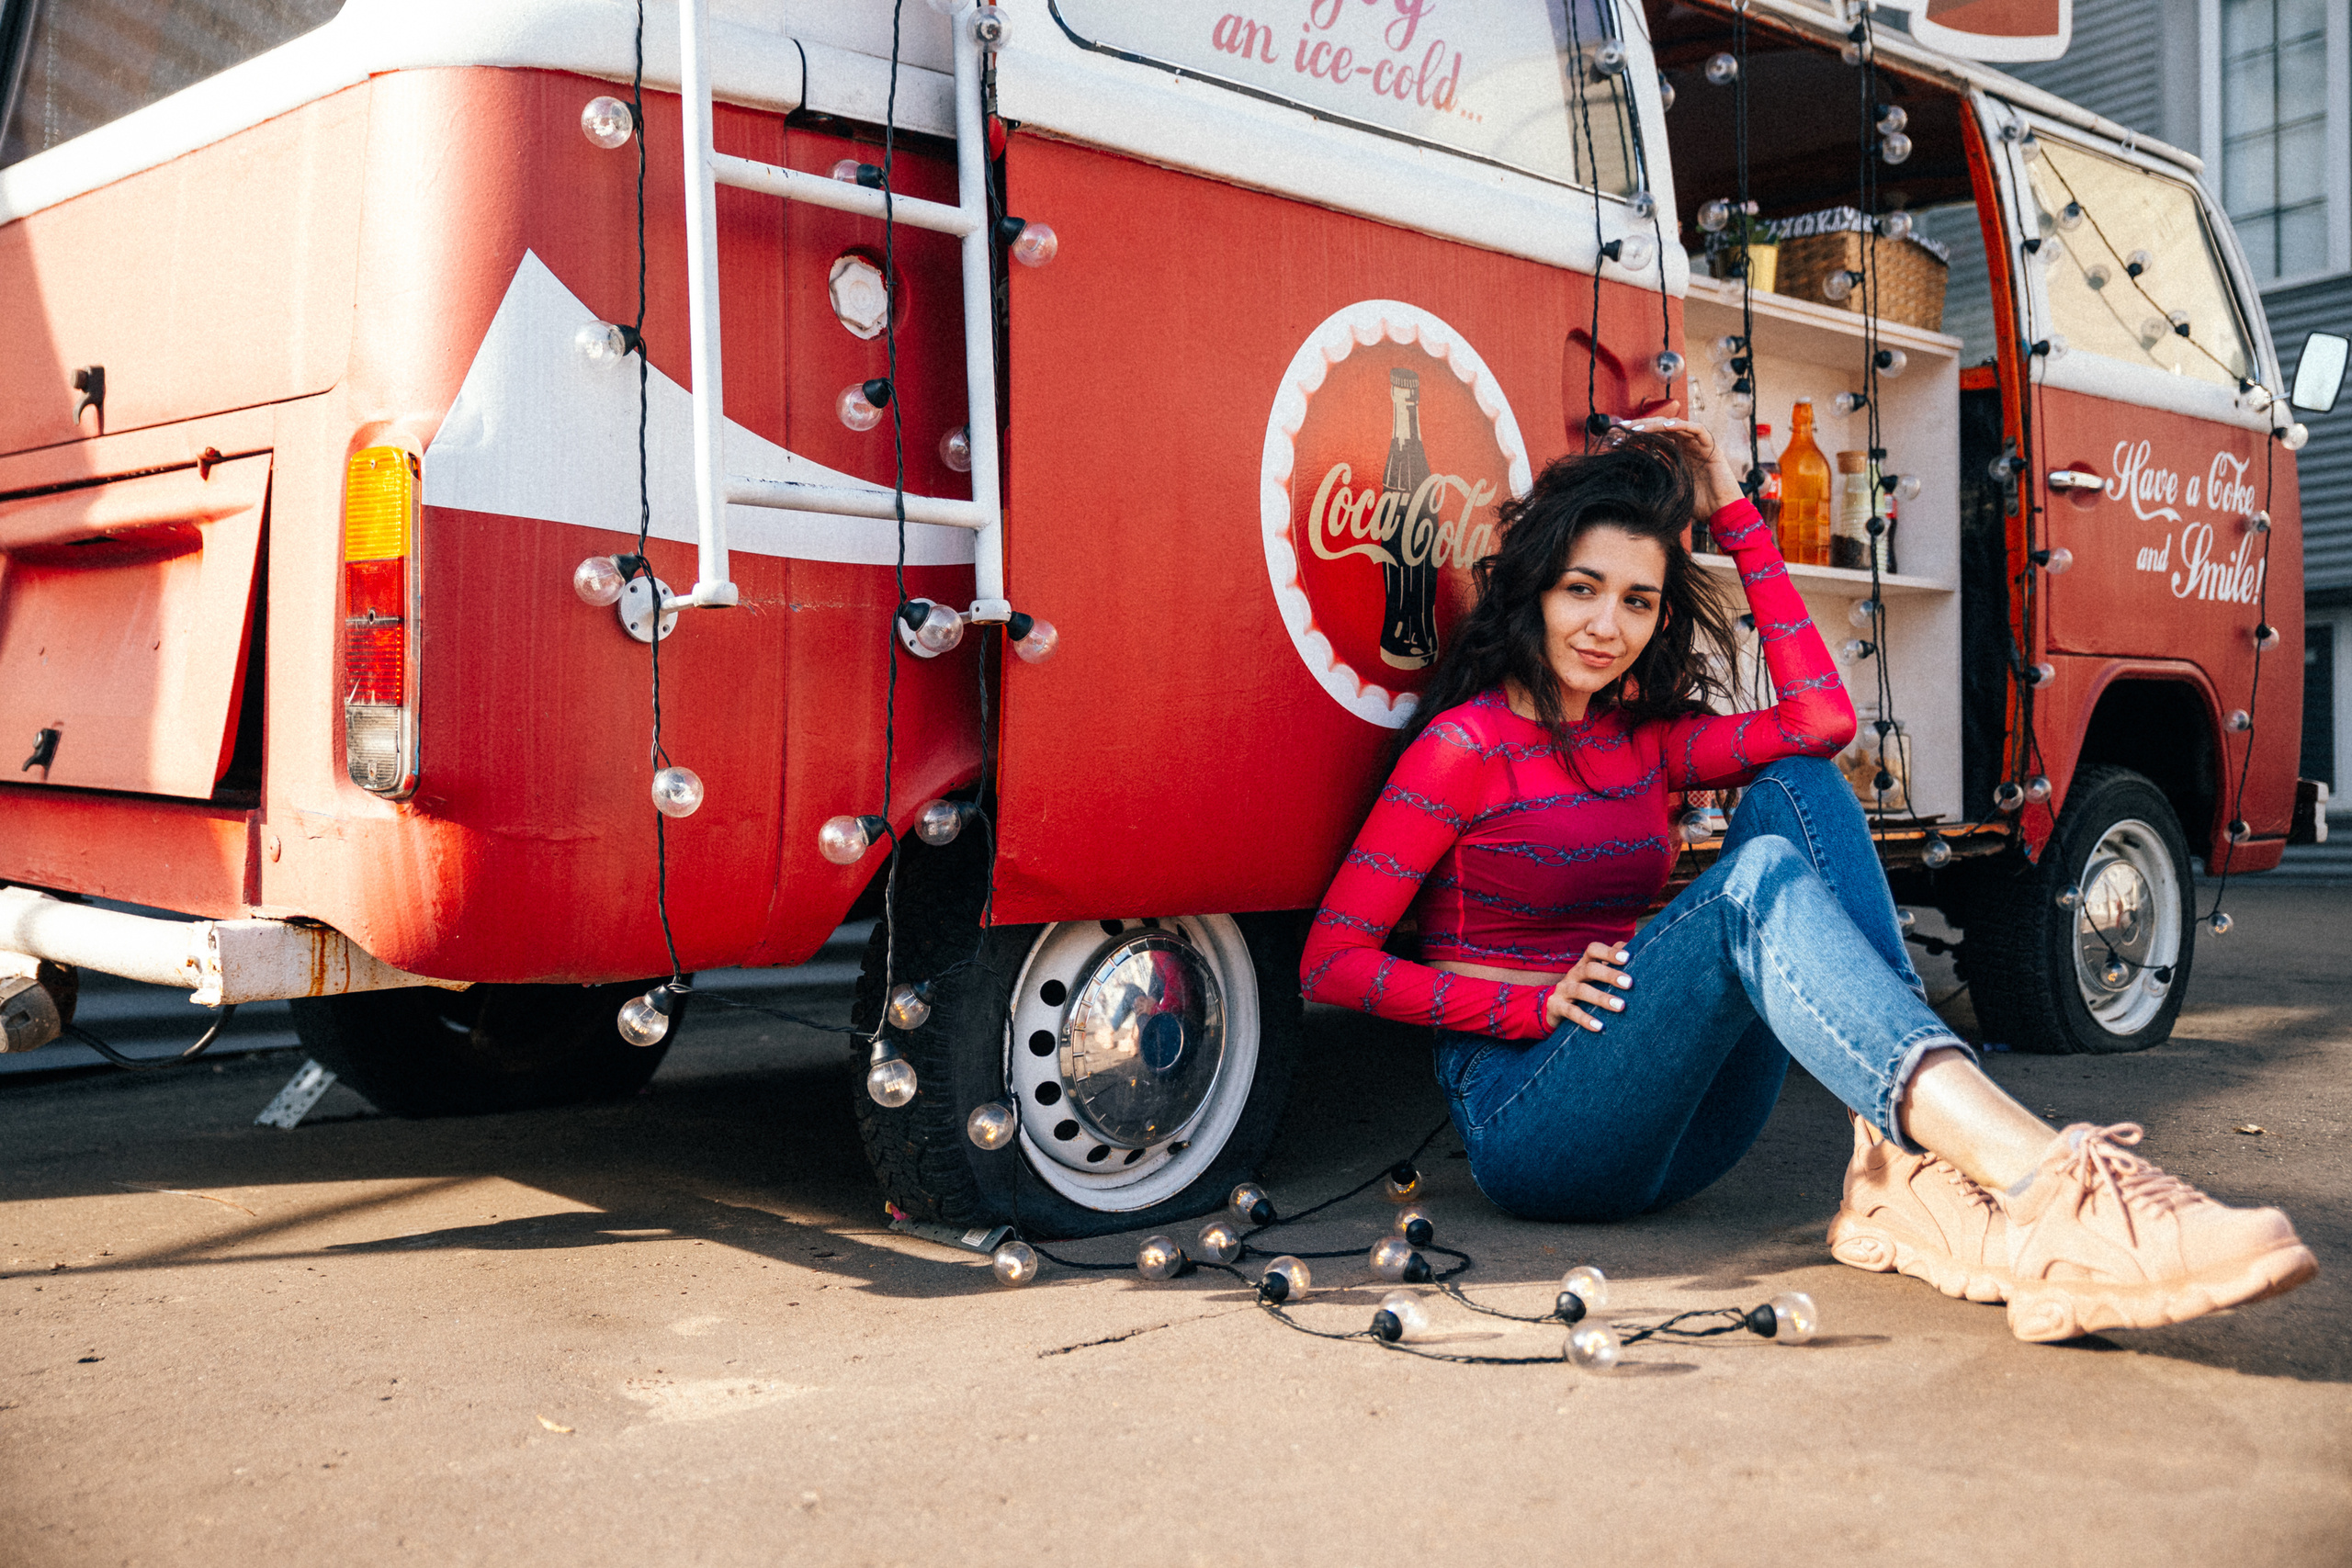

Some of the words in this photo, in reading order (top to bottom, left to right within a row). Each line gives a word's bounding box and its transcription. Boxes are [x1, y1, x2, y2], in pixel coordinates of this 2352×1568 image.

[1212, 14, 1278, 63] an
[2106, 440, 2182, 522] Have
[2186, 475, 2200, 506] a
[2207, 451, 2255, 515] Coke
[2136, 533, 2171, 571] and
[2172, 523, 2265, 604] Smile!
